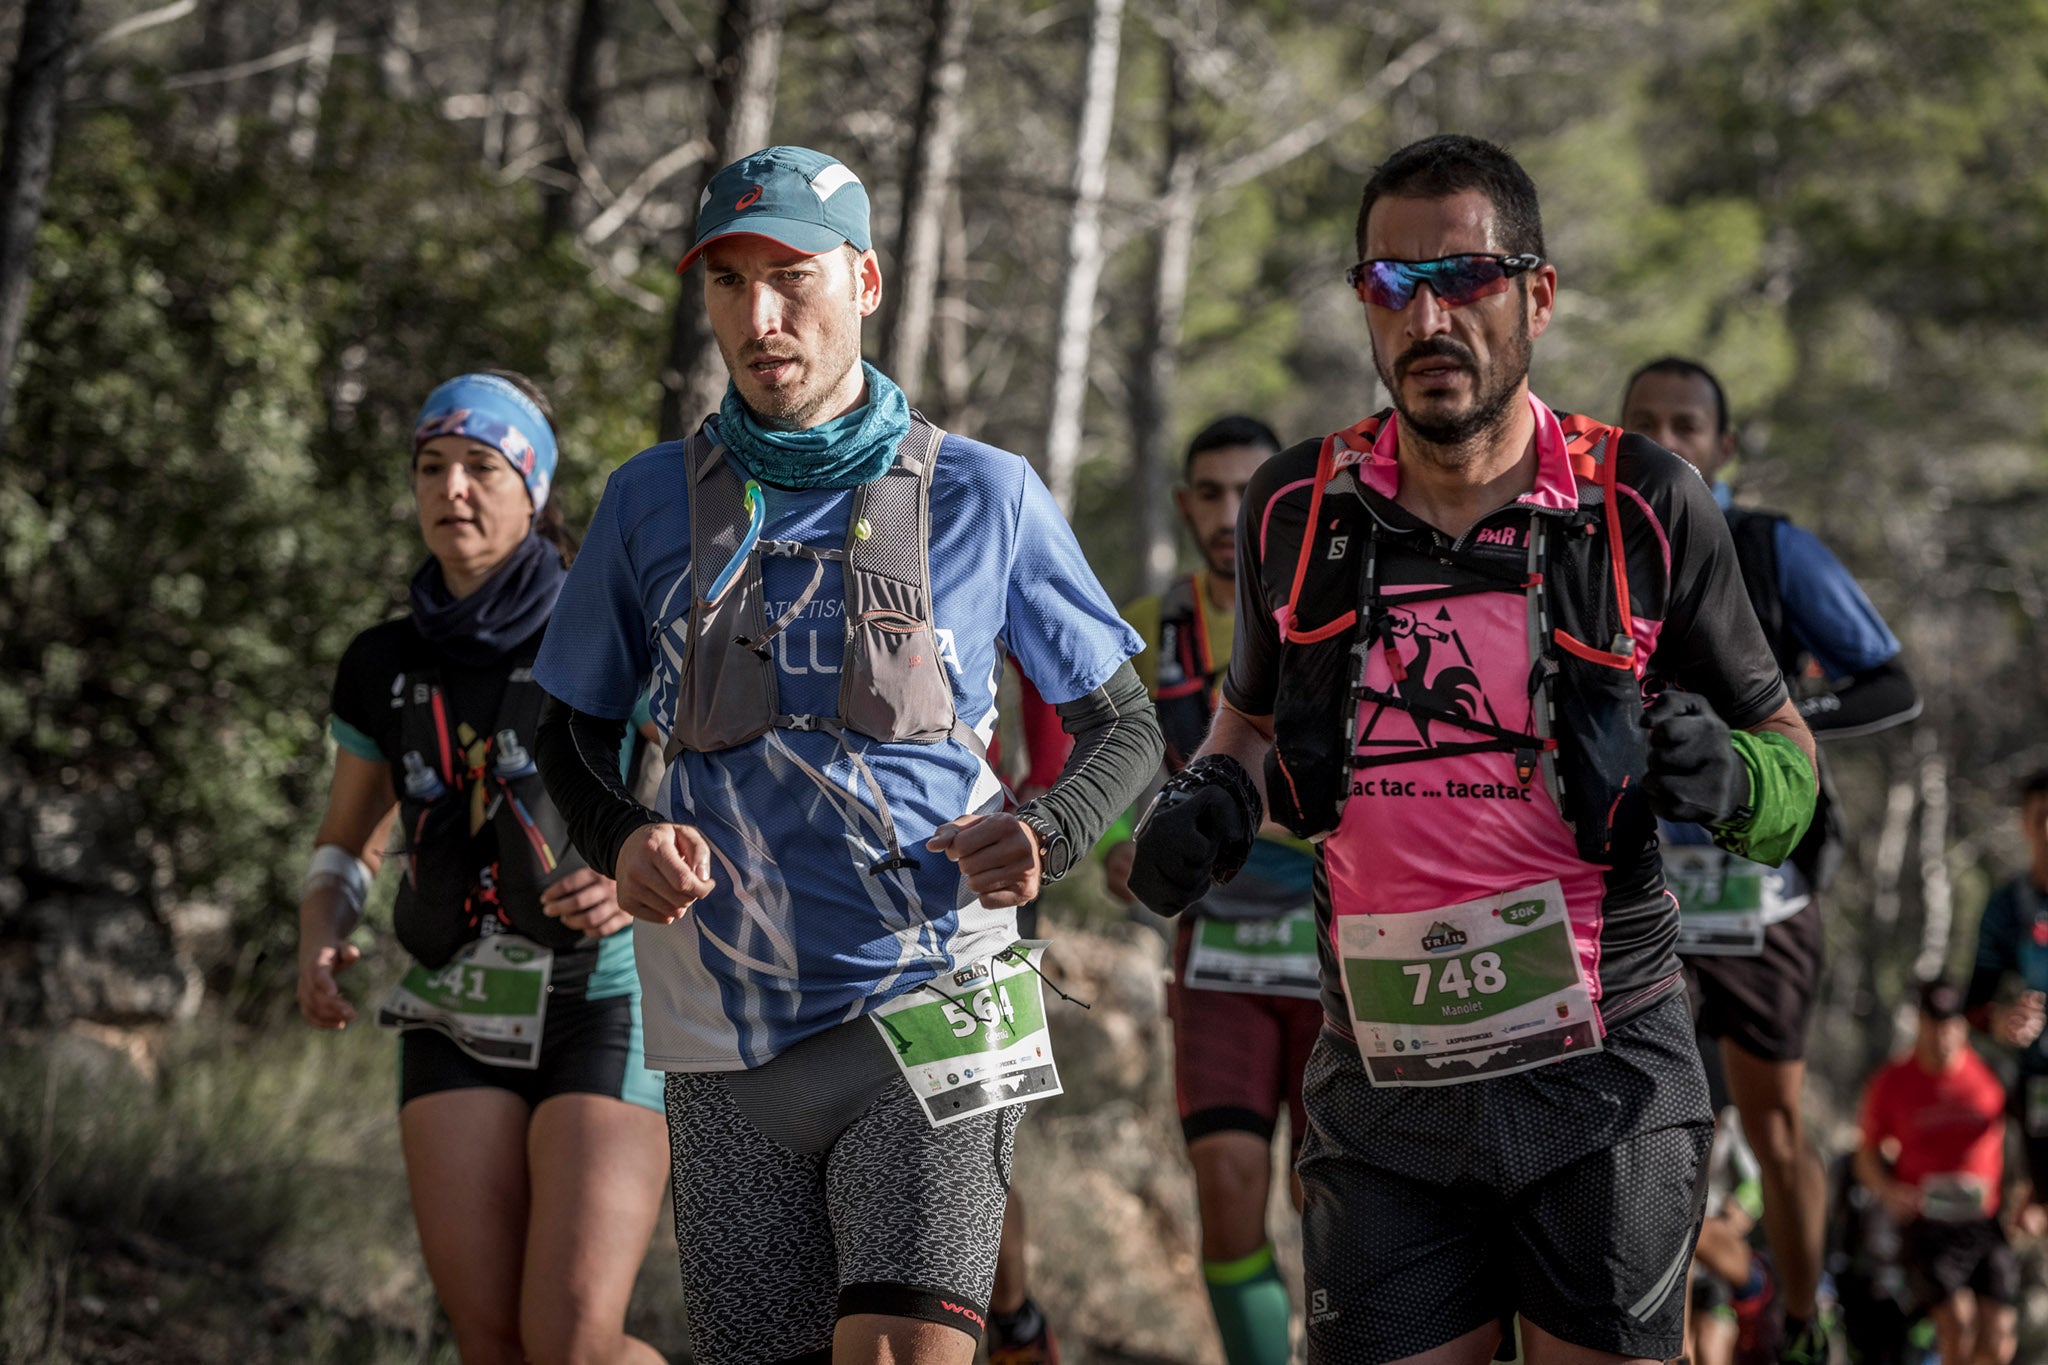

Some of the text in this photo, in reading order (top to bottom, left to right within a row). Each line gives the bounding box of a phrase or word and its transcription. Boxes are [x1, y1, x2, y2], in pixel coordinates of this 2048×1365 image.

[1475, 526, 1517, 546] BAR
[1348, 780, 1376, 797] ac
[1380, 778, 1416, 797] tac
[1446, 780, 1532, 802] tacatac
[1509, 905, 1538, 920] 30K
[1424, 932, 1466, 948] TRAIL
[956, 965, 988, 983] TRAIL
[1402, 951, 1508, 1006] 748
[940, 984, 1015, 1039] 564
[1441, 1000, 1484, 1017] Manolet
